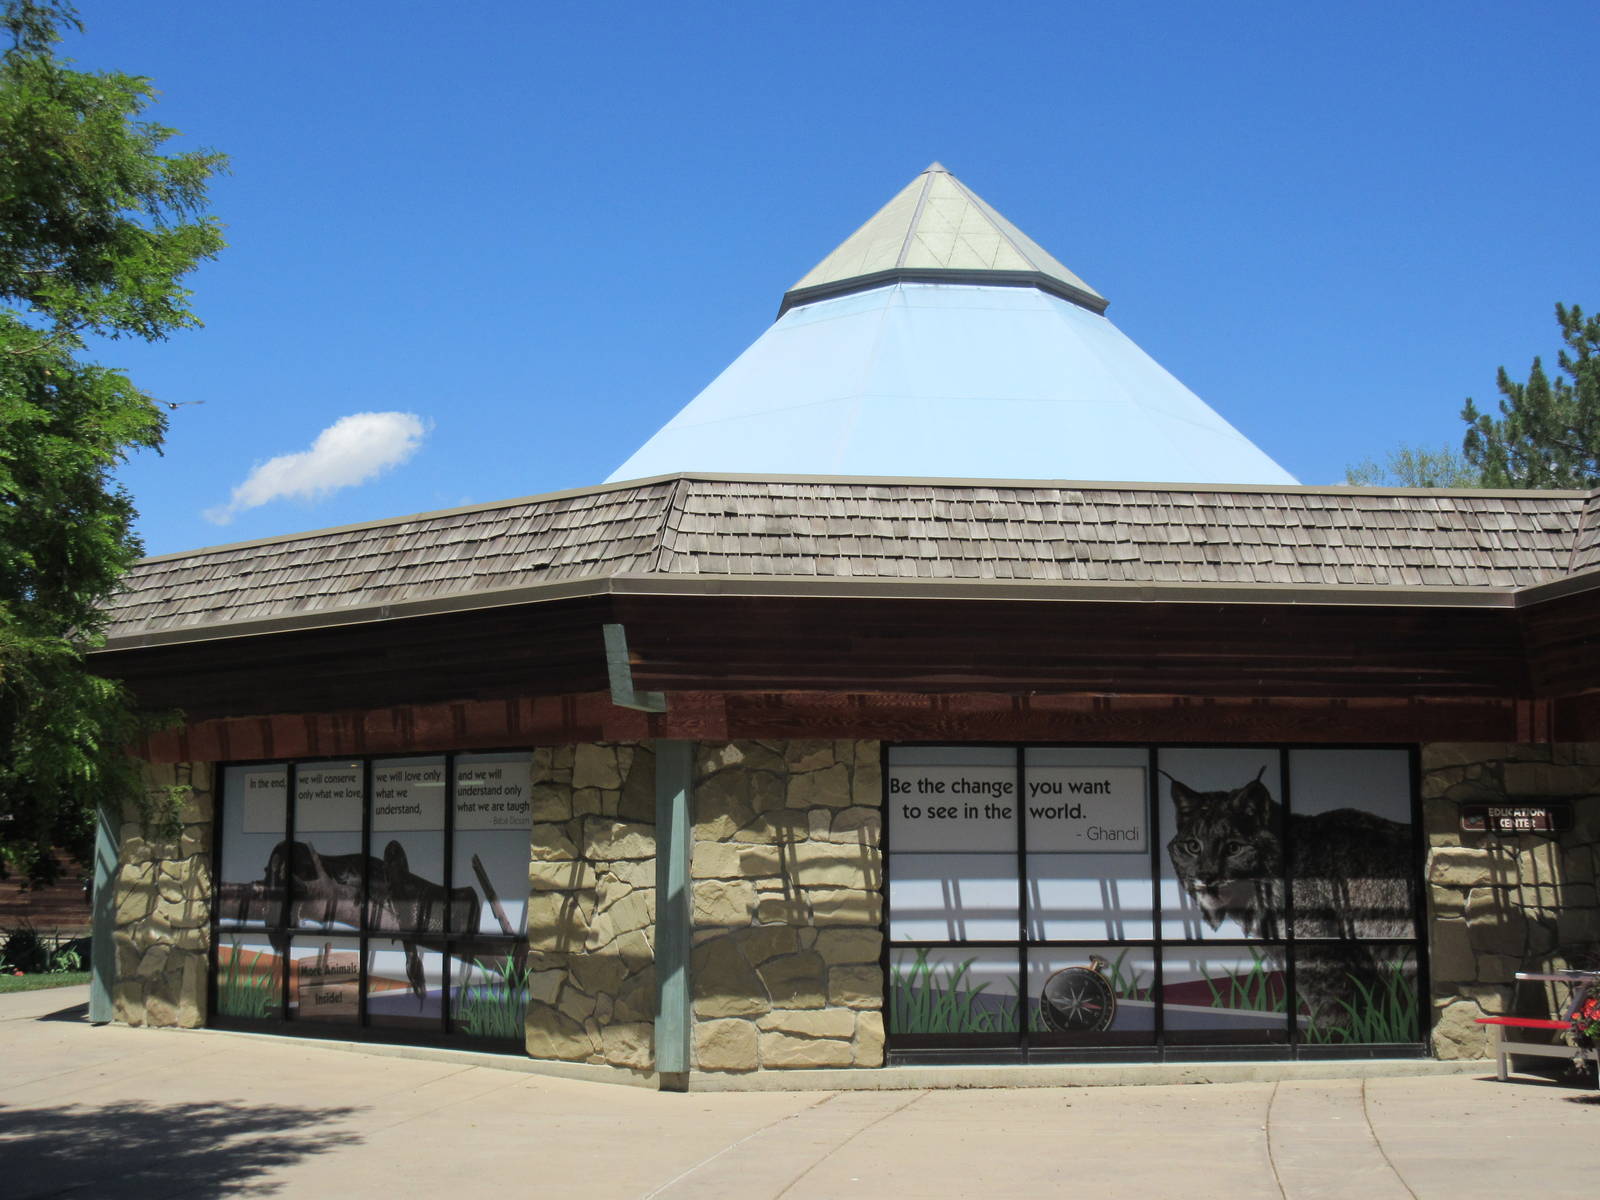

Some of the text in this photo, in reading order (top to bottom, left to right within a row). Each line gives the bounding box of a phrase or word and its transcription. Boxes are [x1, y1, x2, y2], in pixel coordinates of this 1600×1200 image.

[311, 775, 322, 783] will
[324, 775, 357, 784] conserve
[376, 769, 441, 782] we will love only
[457, 768, 502, 780] and we will
[258, 778, 269, 788] the
[271, 778, 287, 789] end,
[890, 778, 1111, 798] Be the change you want
[298, 790, 313, 800] only
[315, 789, 332, 798] what
[346, 788, 363, 799] love,
[376, 788, 408, 798] what we
[457, 784, 522, 797] understand only
[375, 802, 423, 815] understand,
[457, 800, 530, 814] what we are taugh
[903, 803, 1087, 819] to see in the world.
[1488, 808, 1546, 817] EDUCATION
[1500, 818, 1537, 828] CENTER
[1086, 826, 1140, 841] Ghandi
[324, 962, 357, 975] Animals
